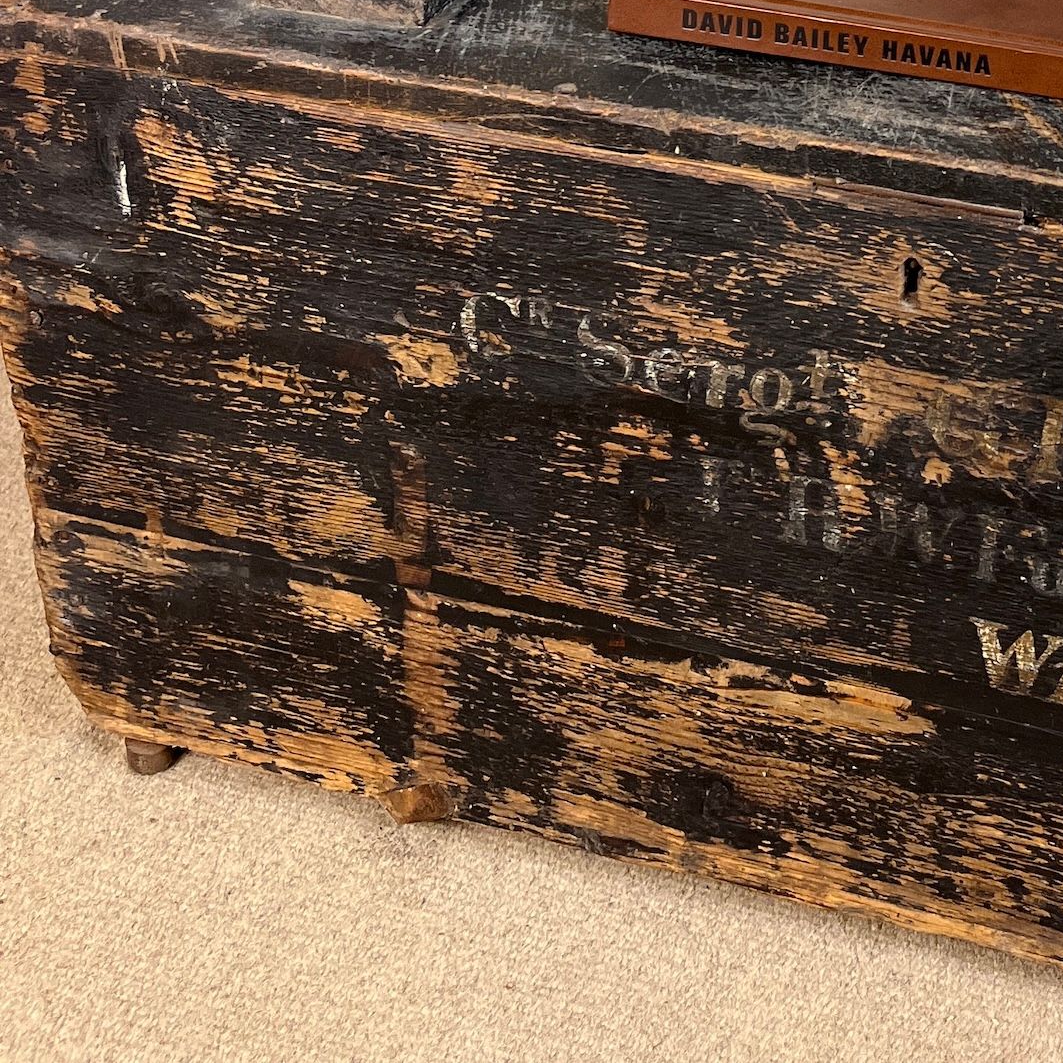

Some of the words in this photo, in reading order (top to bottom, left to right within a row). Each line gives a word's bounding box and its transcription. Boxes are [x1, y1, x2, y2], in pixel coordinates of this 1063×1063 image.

[682, 8, 763, 40] DAVID
[774, 23, 869, 57] BAILEY
[883, 39, 992, 76] HAVANA
